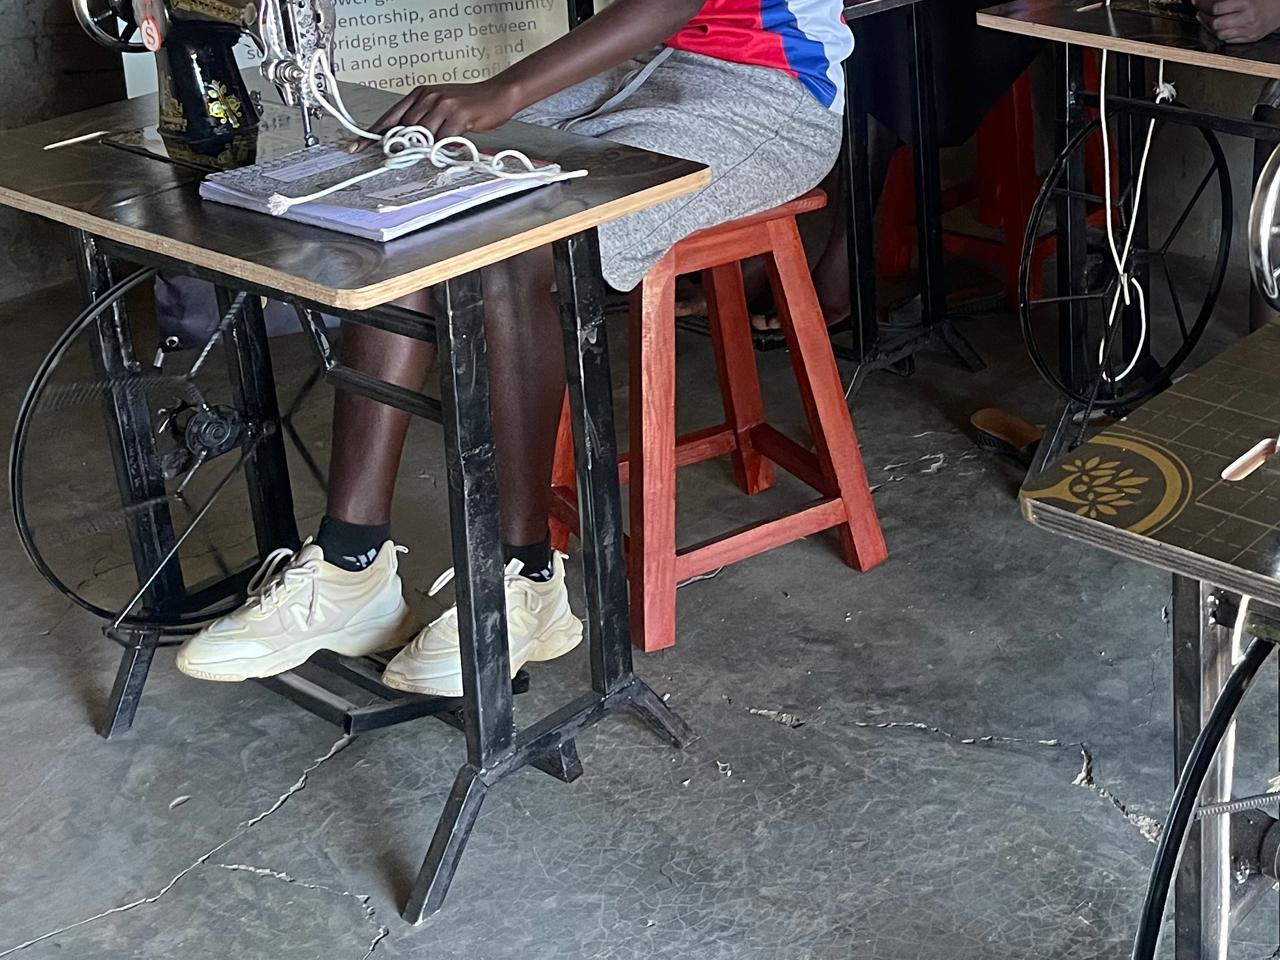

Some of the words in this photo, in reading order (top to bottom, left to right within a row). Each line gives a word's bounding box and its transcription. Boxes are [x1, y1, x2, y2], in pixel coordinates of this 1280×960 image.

[337, 7, 424, 29] entorship,
[428, 4, 460, 21] and
[145, 26, 156, 45] S
[402, 28, 434, 44] the
[434, 28, 464, 44] gap
[468, 19, 537, 37] between
[351, 54, 382, 71] and
[387, 44, 490, 69] opportunity,
[494, 38, 525, 56] and
[442, 66, 458, 82] of
